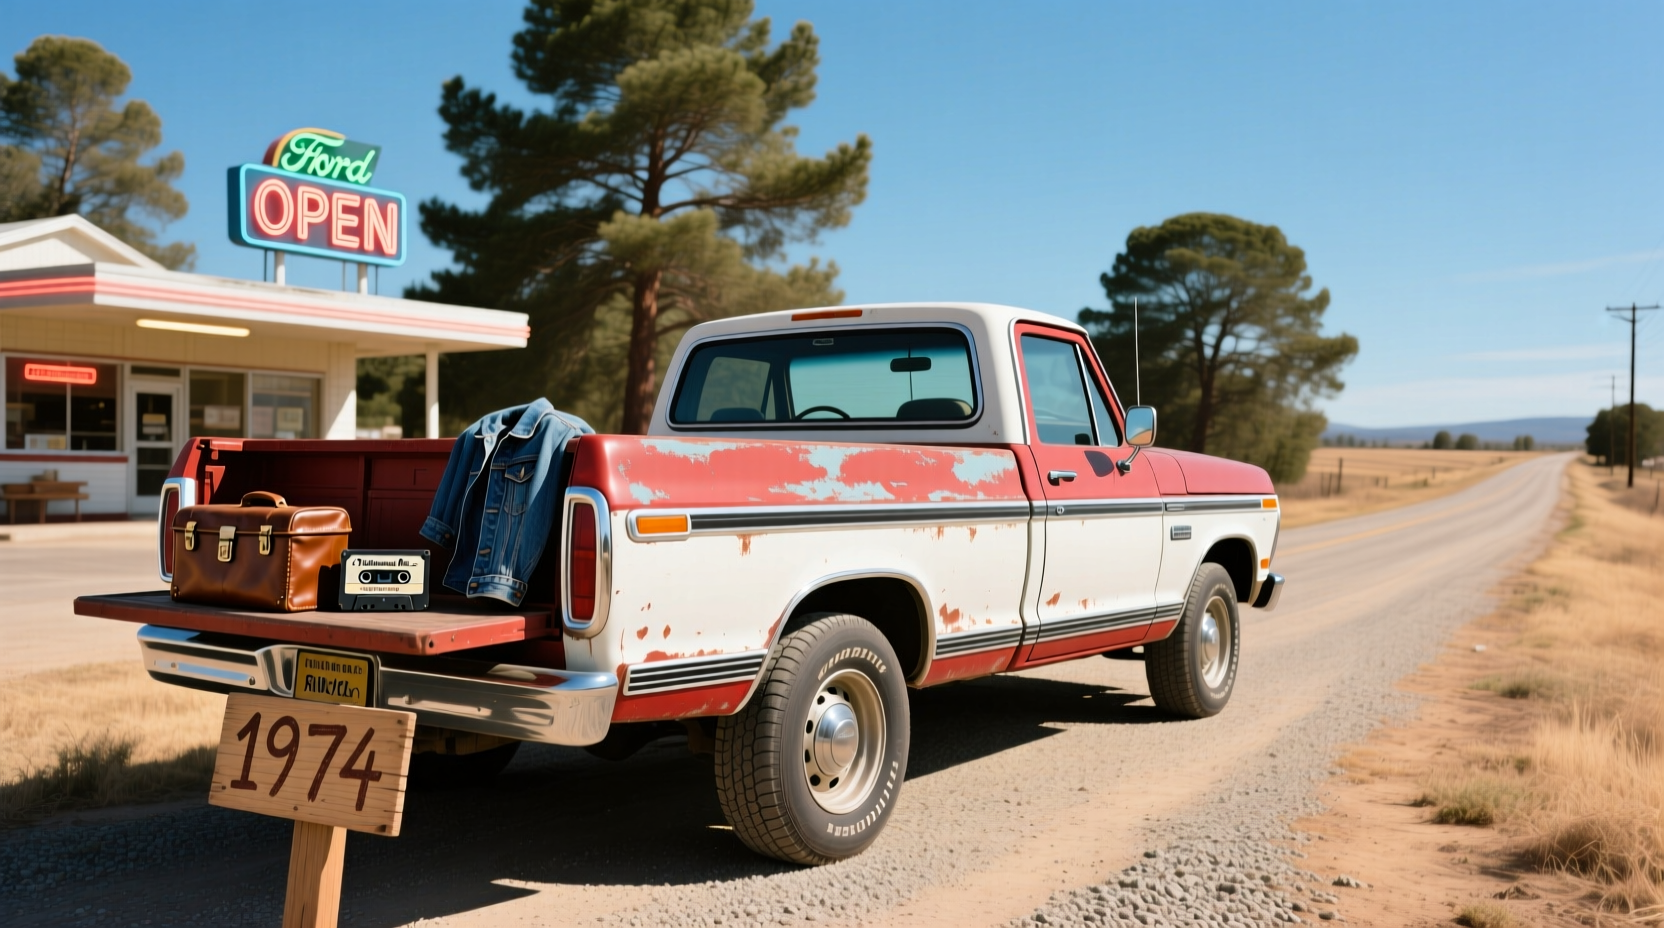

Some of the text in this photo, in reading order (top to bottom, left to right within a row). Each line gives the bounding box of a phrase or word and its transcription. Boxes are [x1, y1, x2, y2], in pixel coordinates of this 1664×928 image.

[281, 132, 375, 184] Ford
[254, 178, 398, 257] OPEN
[230, 712, 382, 811] 1974
